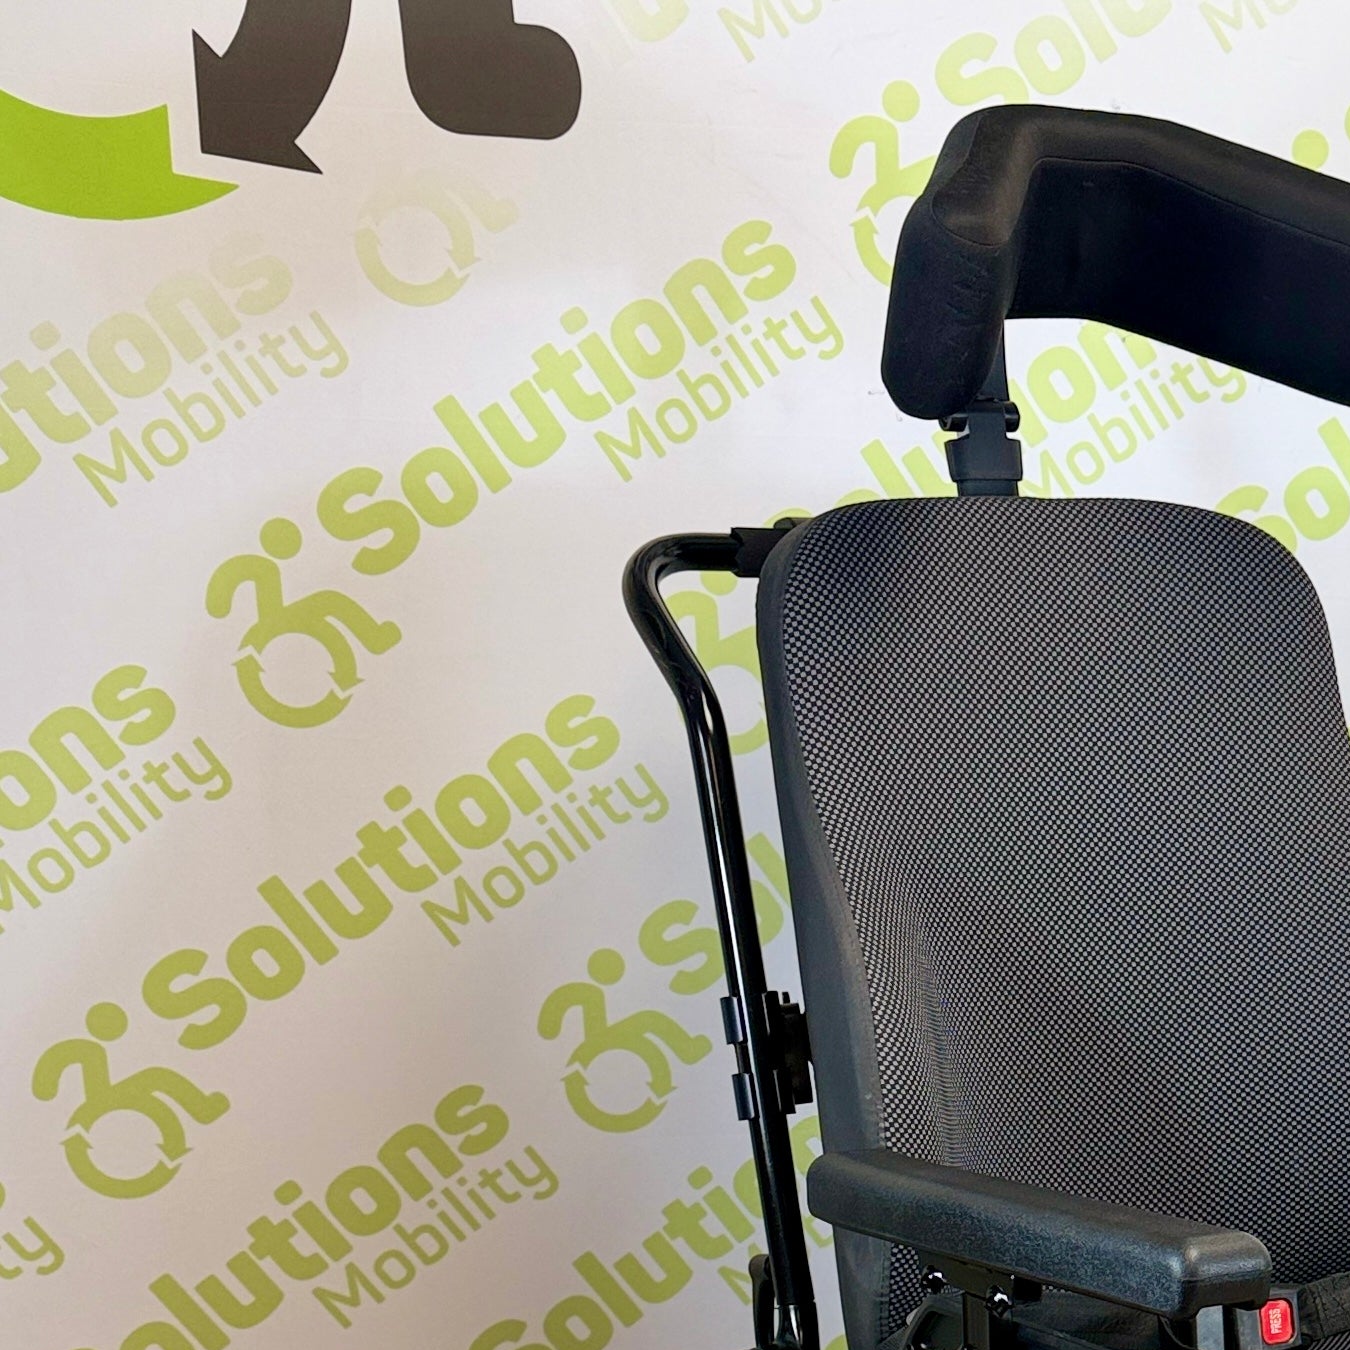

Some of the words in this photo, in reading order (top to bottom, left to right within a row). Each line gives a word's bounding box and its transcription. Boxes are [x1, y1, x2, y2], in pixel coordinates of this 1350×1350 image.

[73, 309, 349, 508] Mobility
[316, 220, 798, 577] Solutions
[593, 295, 845, 483] Mobility
[141, 694, 622, 1052] Solutions
[421, 763, 670, 948] Mobility
[313, 1145, 560, 1330] Mobility
[1268, 1308, 1283, 1335] PRESS
